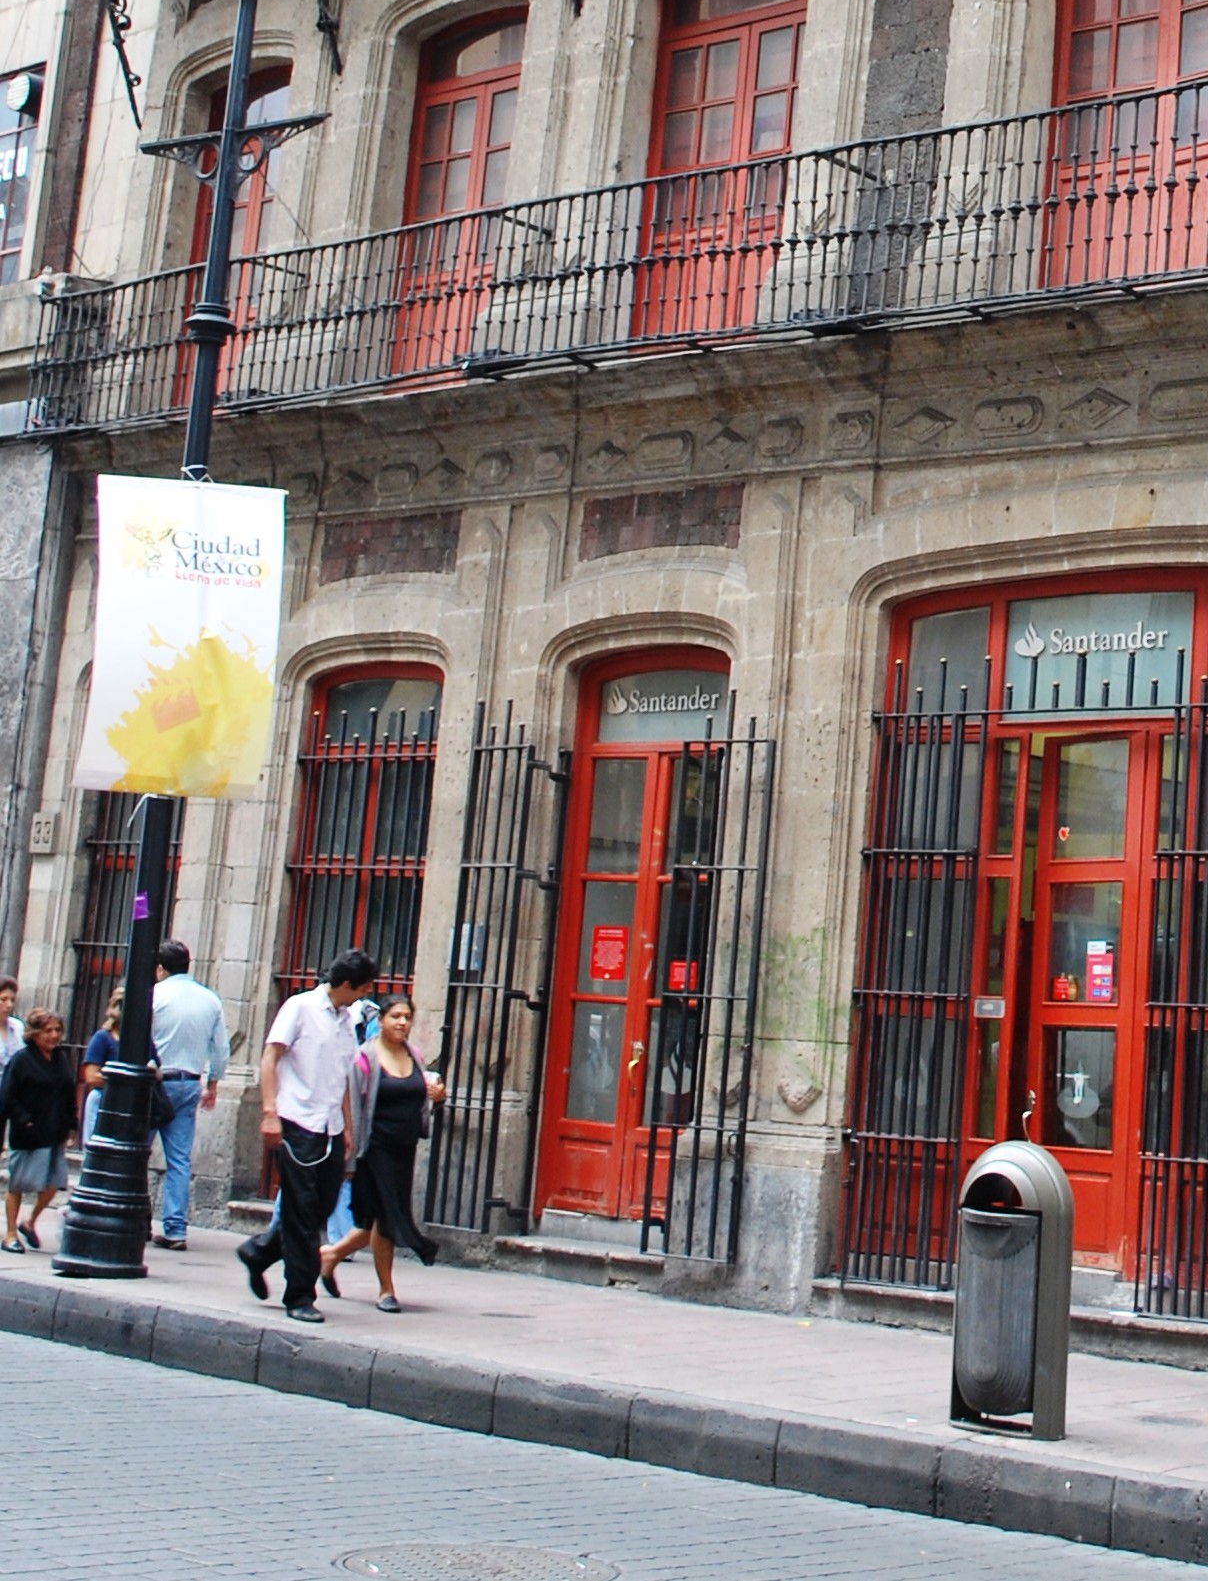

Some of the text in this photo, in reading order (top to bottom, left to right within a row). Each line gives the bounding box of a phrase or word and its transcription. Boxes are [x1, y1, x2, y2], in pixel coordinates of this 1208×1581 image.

[171, 530, 260, 557] Ciudad
[175, 550, 262, 577] México
[1050, 621, 1168, 654] Santander
[628, 685, 719, 713] Santander
[33, 821, 51, 844] 33
